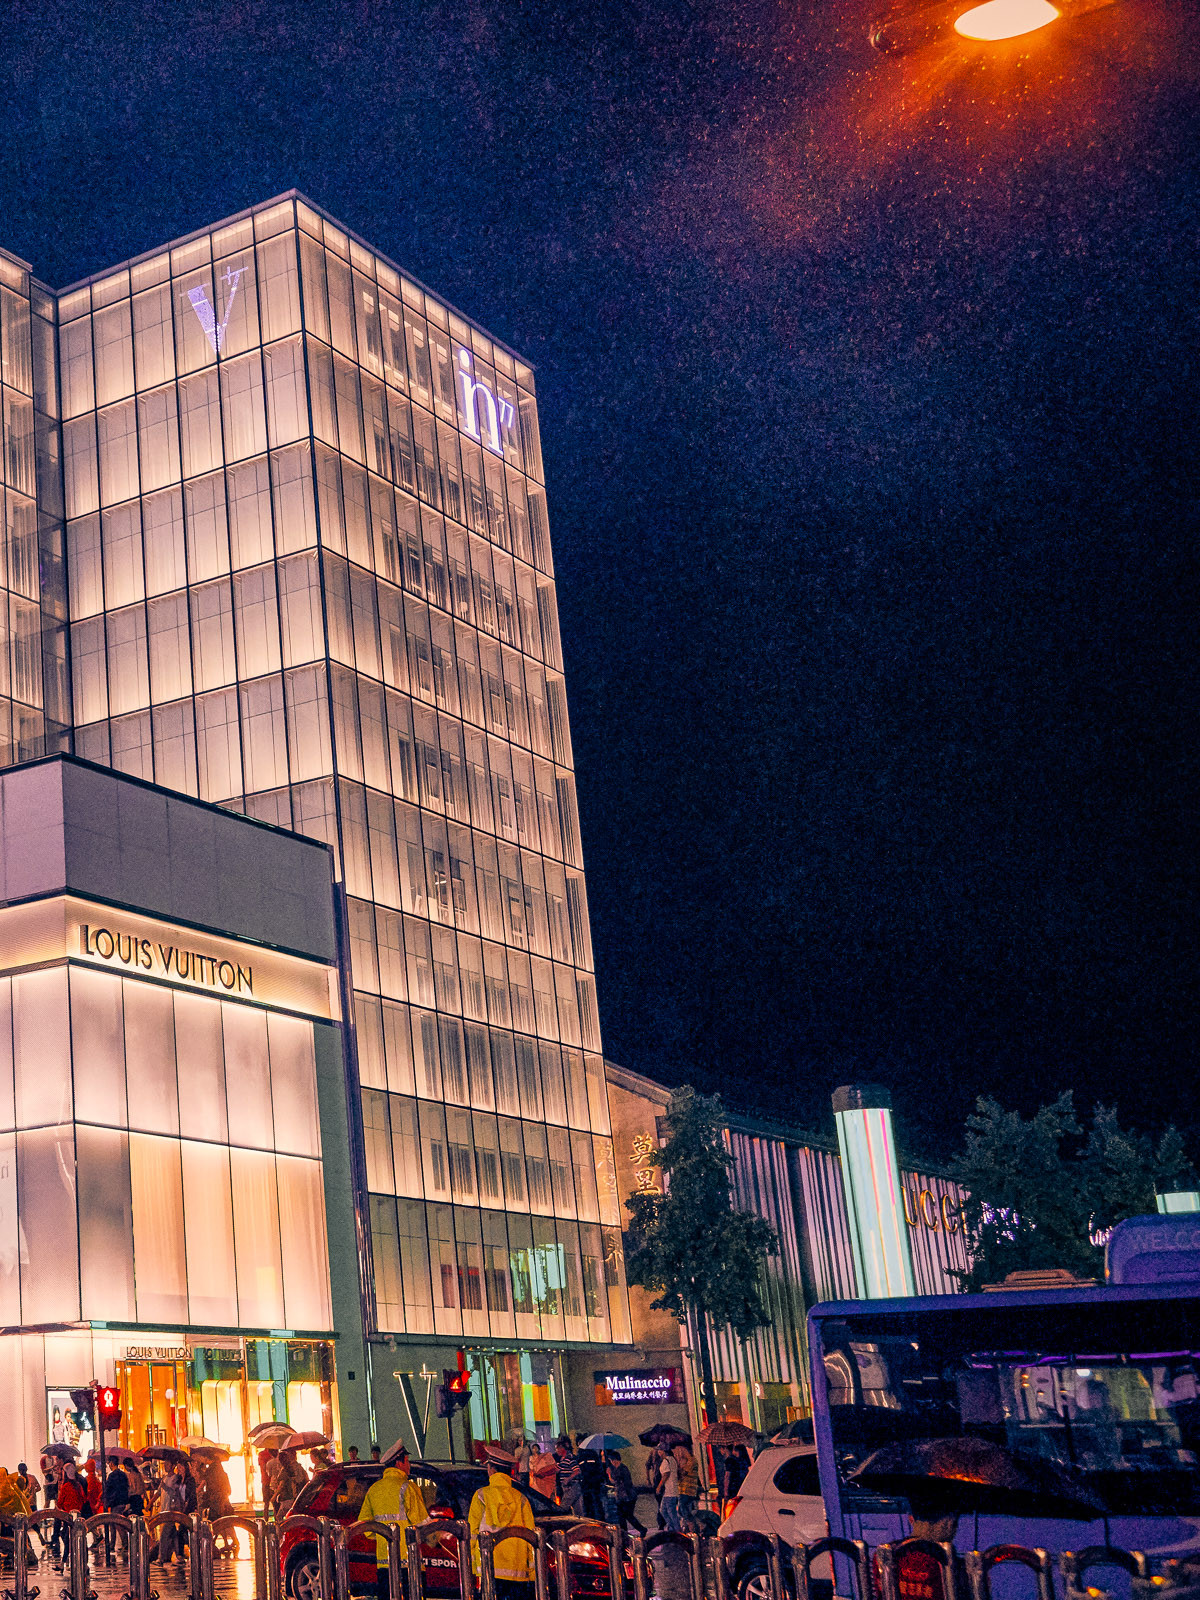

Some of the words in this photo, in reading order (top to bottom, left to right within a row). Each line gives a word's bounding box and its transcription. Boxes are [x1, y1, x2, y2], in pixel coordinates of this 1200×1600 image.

[80, 924, 153, 970] LOUIS
[157, 943, 254, 995] VUITTON
[900, 1186, 968, 1235] UCCI
[126, 1346, 152, 1358] LOUIS
[154, 1347, 192, 1359] VUITTON
[605, 1375, 671, 1391] Mulinaccio
[430, 1558, 460, 1569] SPOR
